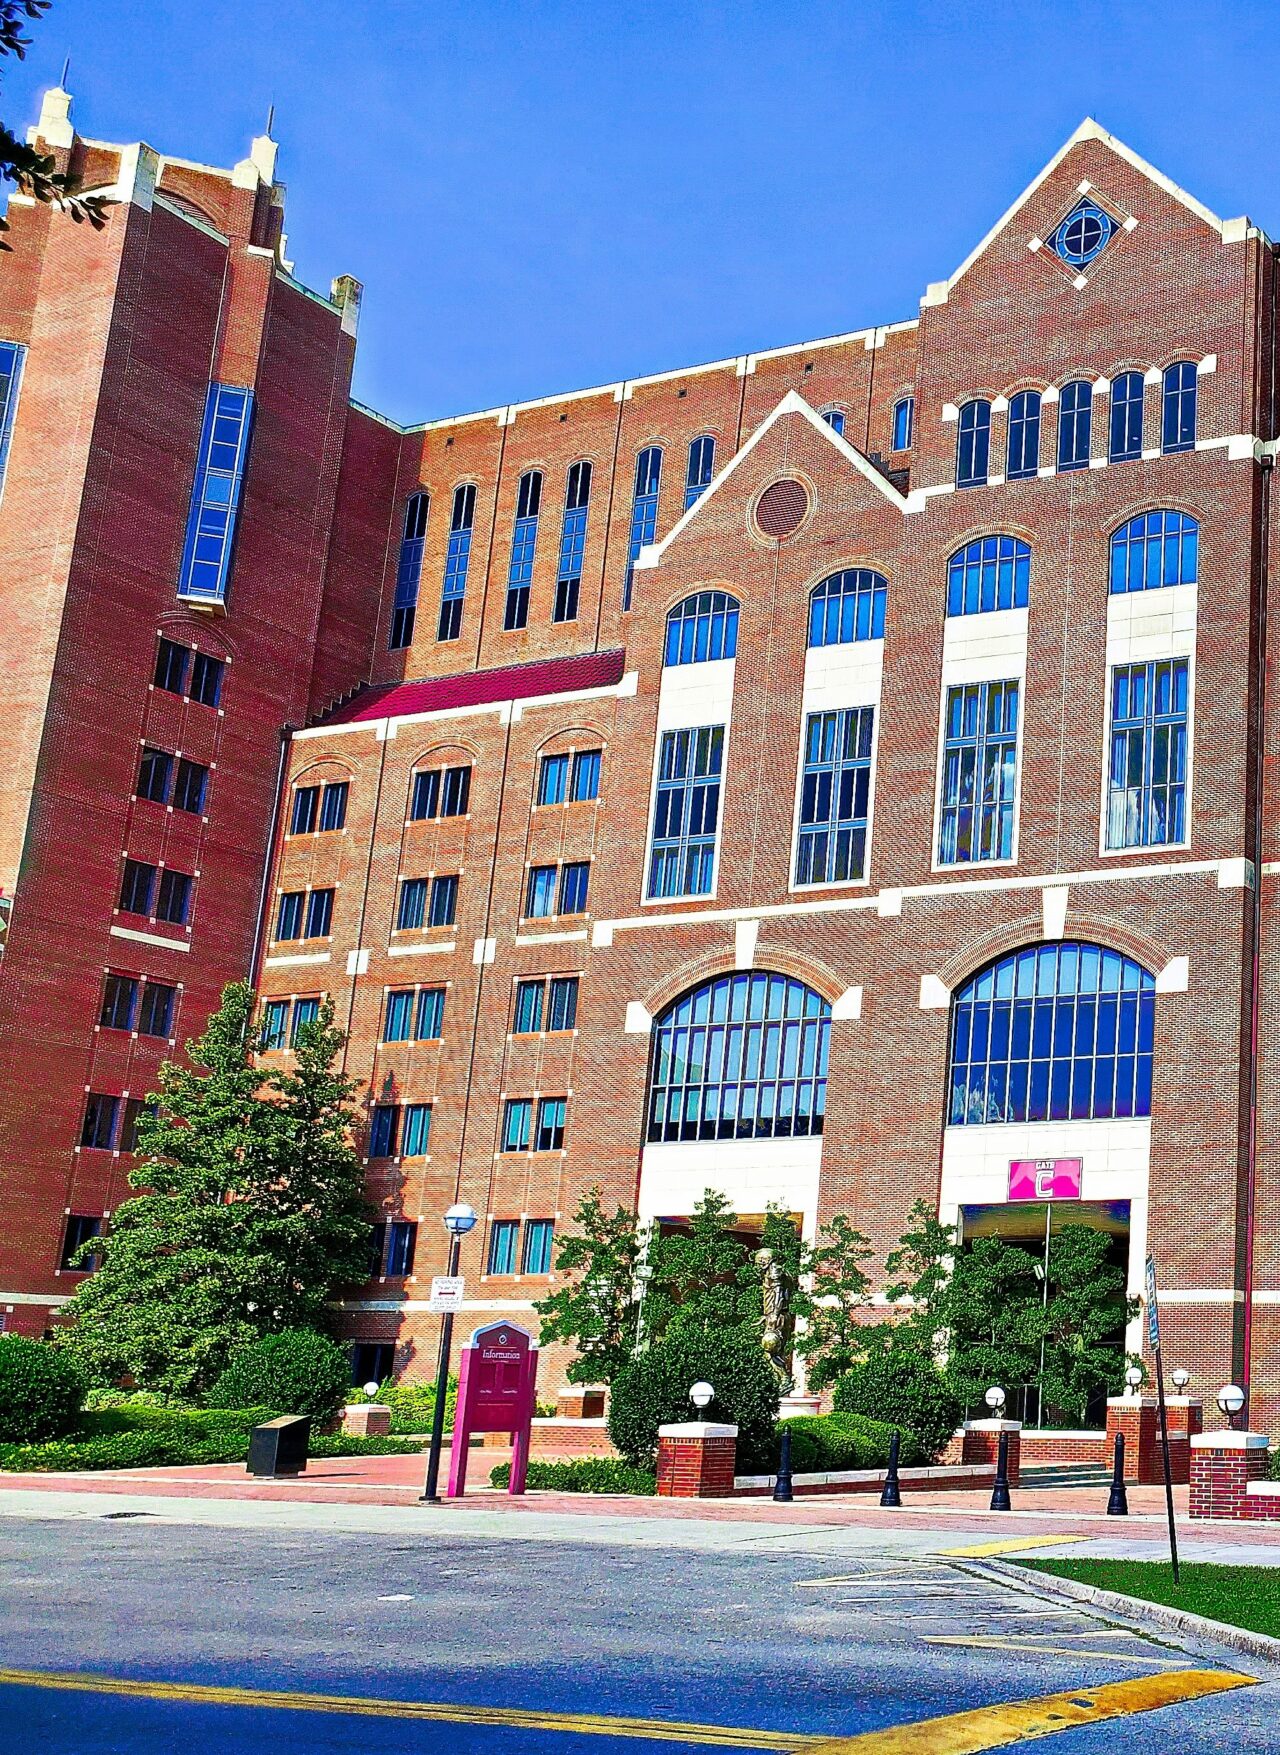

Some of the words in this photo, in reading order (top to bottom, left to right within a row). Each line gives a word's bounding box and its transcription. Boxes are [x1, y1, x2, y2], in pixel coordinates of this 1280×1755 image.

[1035, 1161, 1055, 1169] GATE
[1036, 1170, 1054, 1197] C
[482, 1349, 520, 1359] Information
